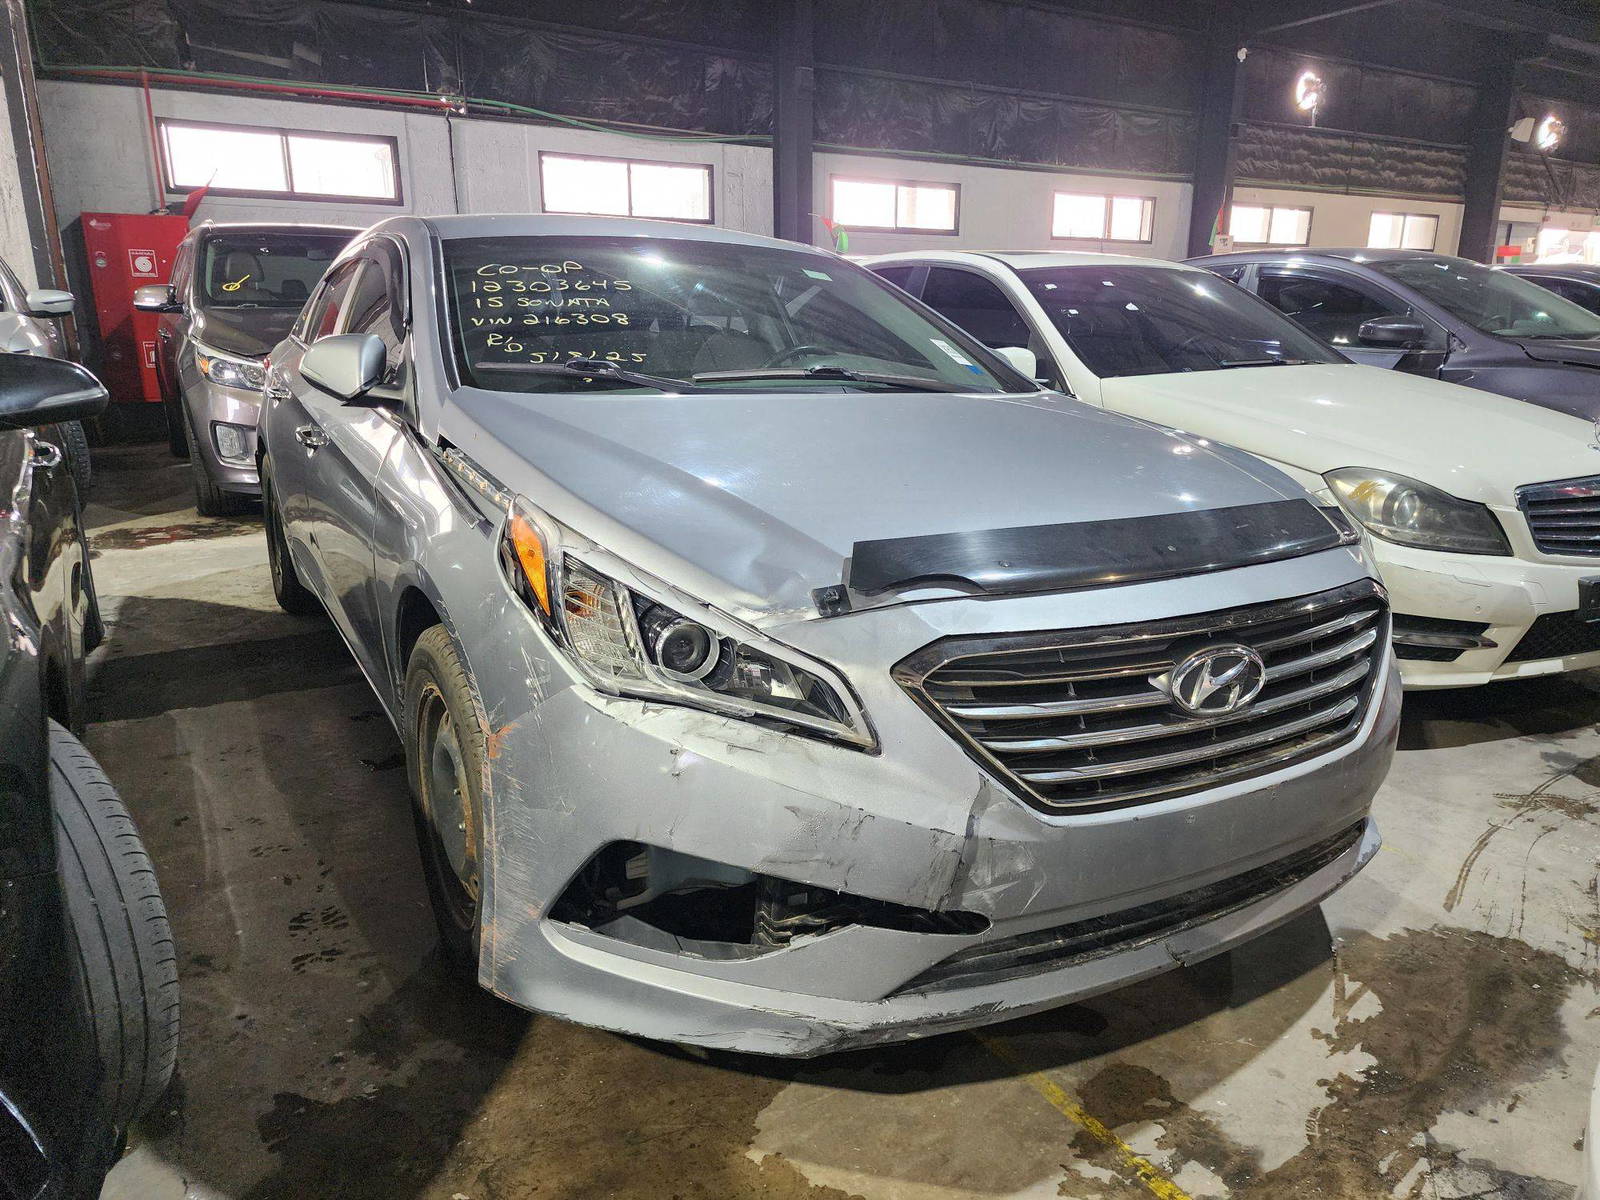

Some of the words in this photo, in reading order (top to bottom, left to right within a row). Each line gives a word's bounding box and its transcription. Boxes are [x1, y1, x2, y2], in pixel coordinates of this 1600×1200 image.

[476, 261, 583, 276] CO-OP
[471, 280, 632, 292] 12303645
[476, 297, 503, 308] 15
[517, 297, 611, 309] SONATA
[471, 317, 512, 326] VIN
[523, 313, 630, 325] 216308
